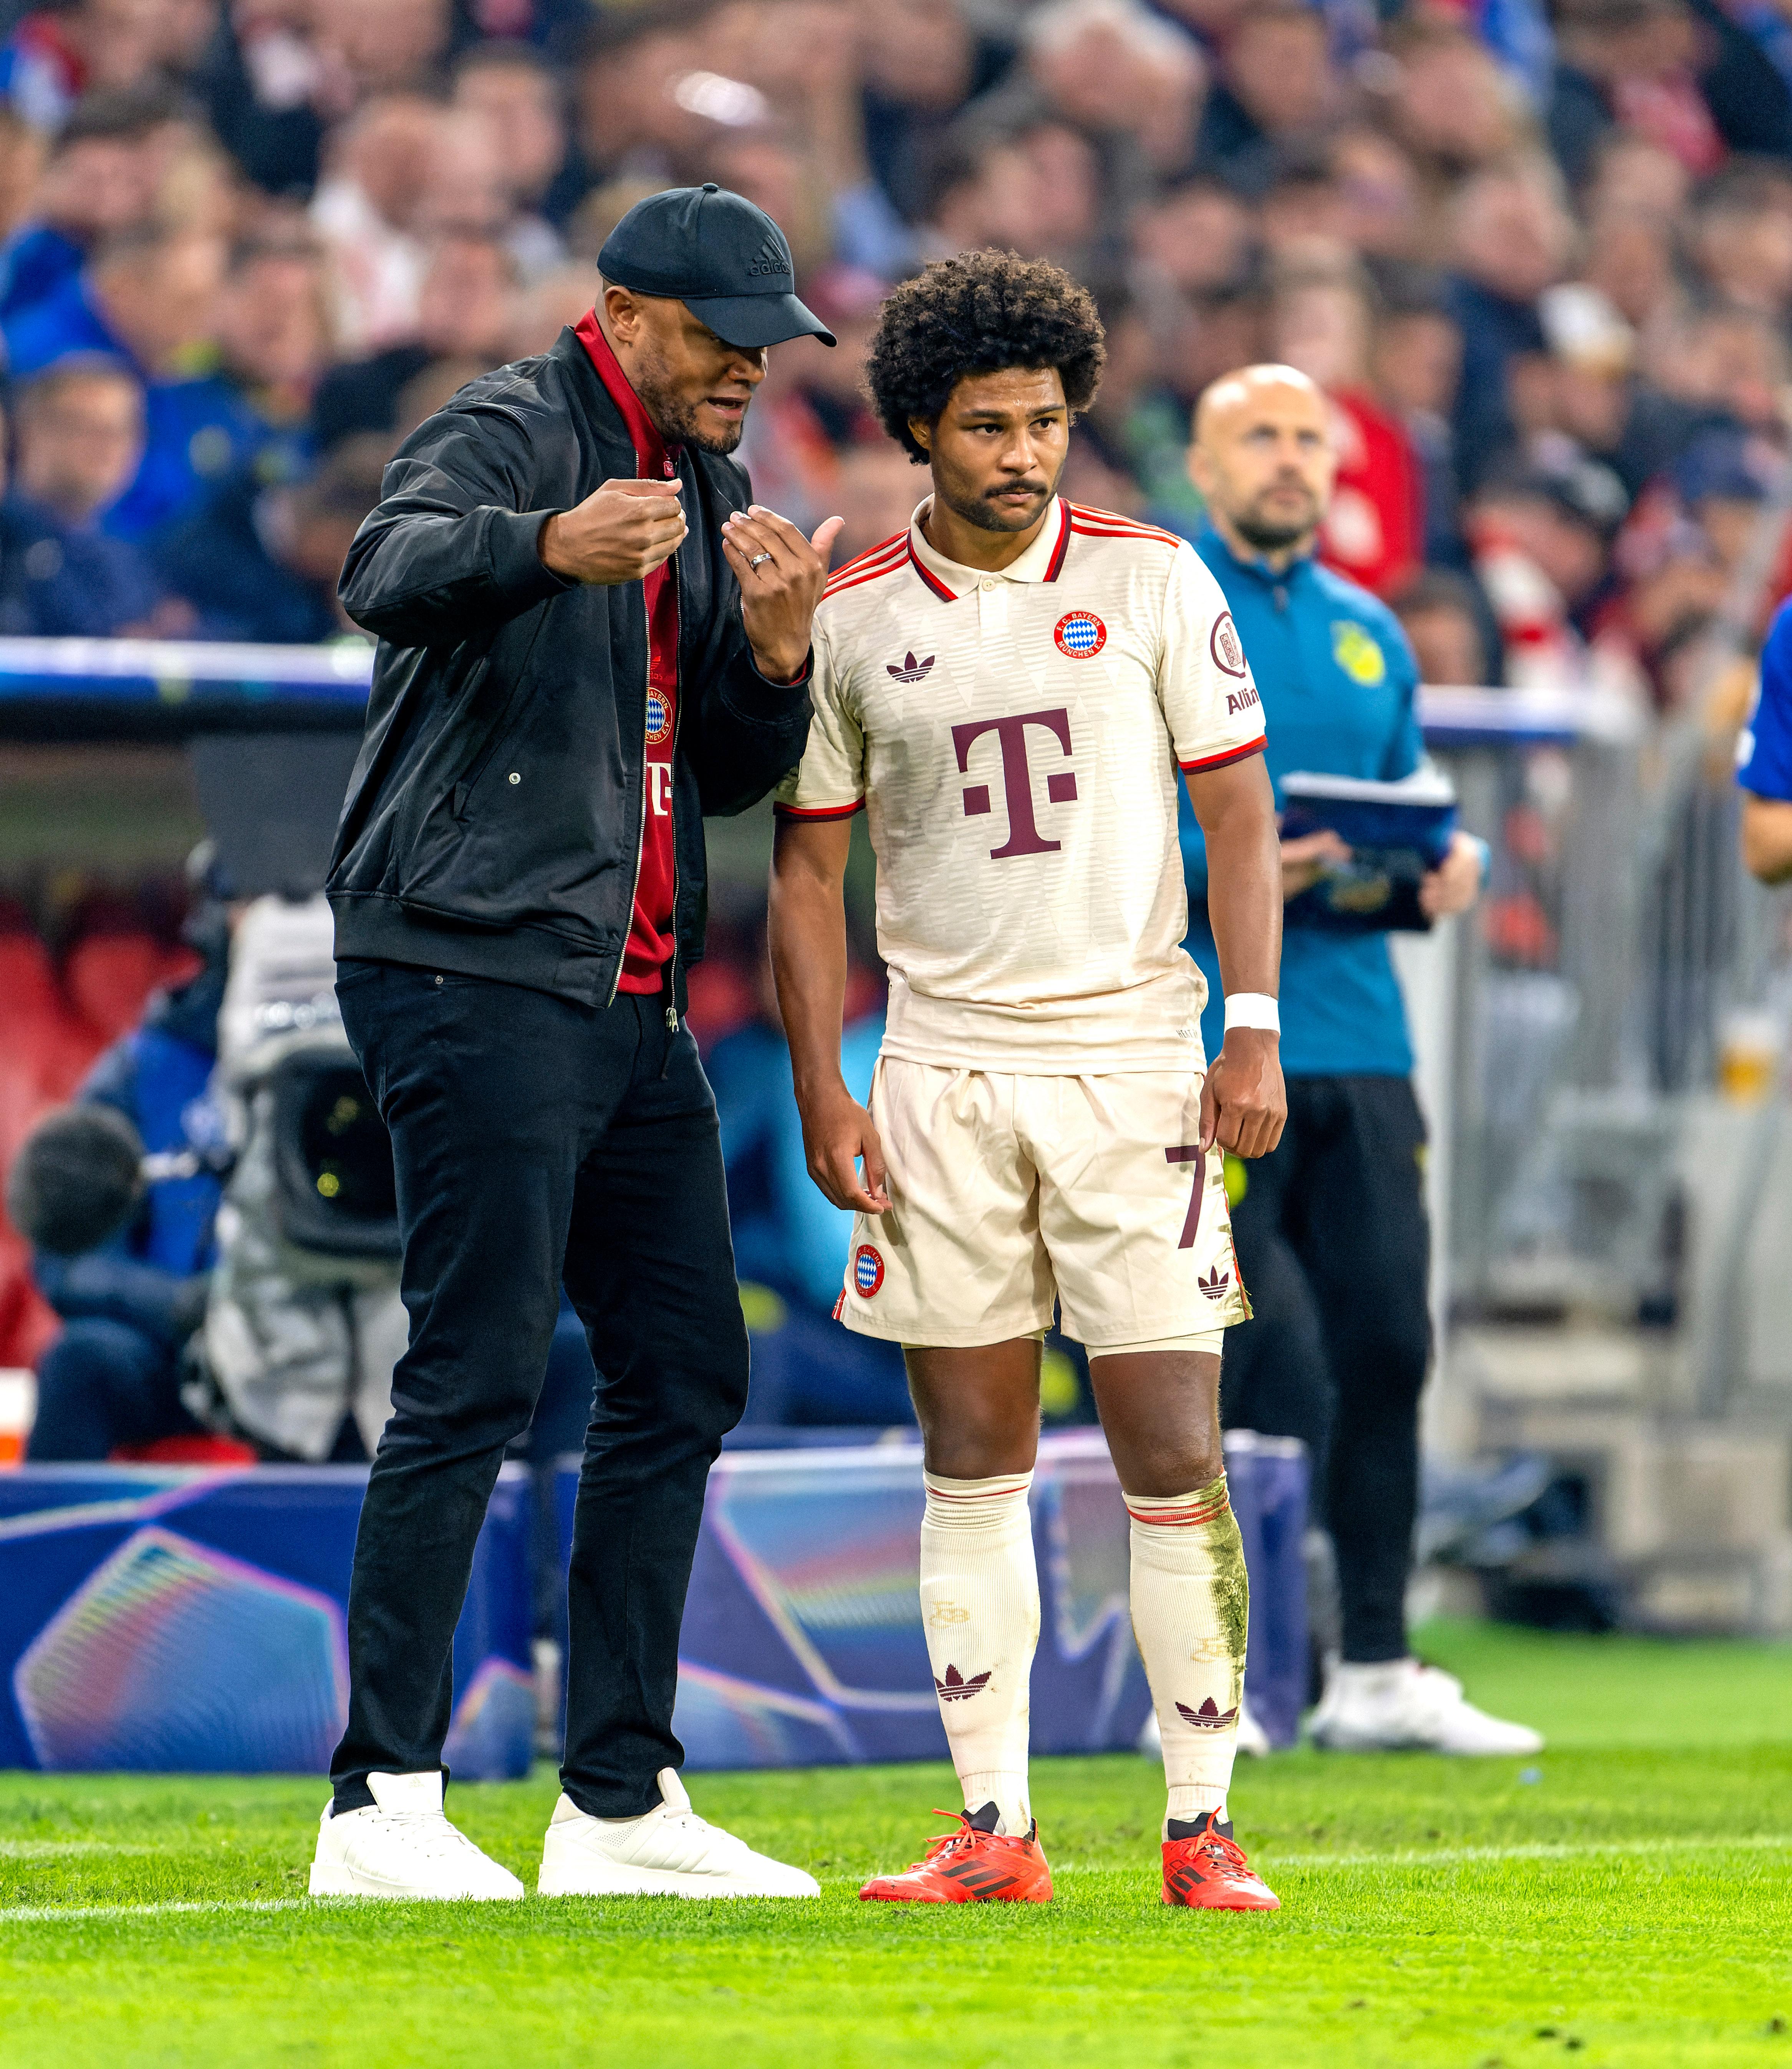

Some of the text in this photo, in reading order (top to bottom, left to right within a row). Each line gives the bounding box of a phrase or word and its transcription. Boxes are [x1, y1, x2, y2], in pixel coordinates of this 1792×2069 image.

[750, 260, 791, 276] adidas
[1072, 612, 1102, 627] BAYERN
[1094, 636, 1105, 650] E.V.
[951, 708, 1078, 859] T
[1165, 1144, 1206, 1249] 7
